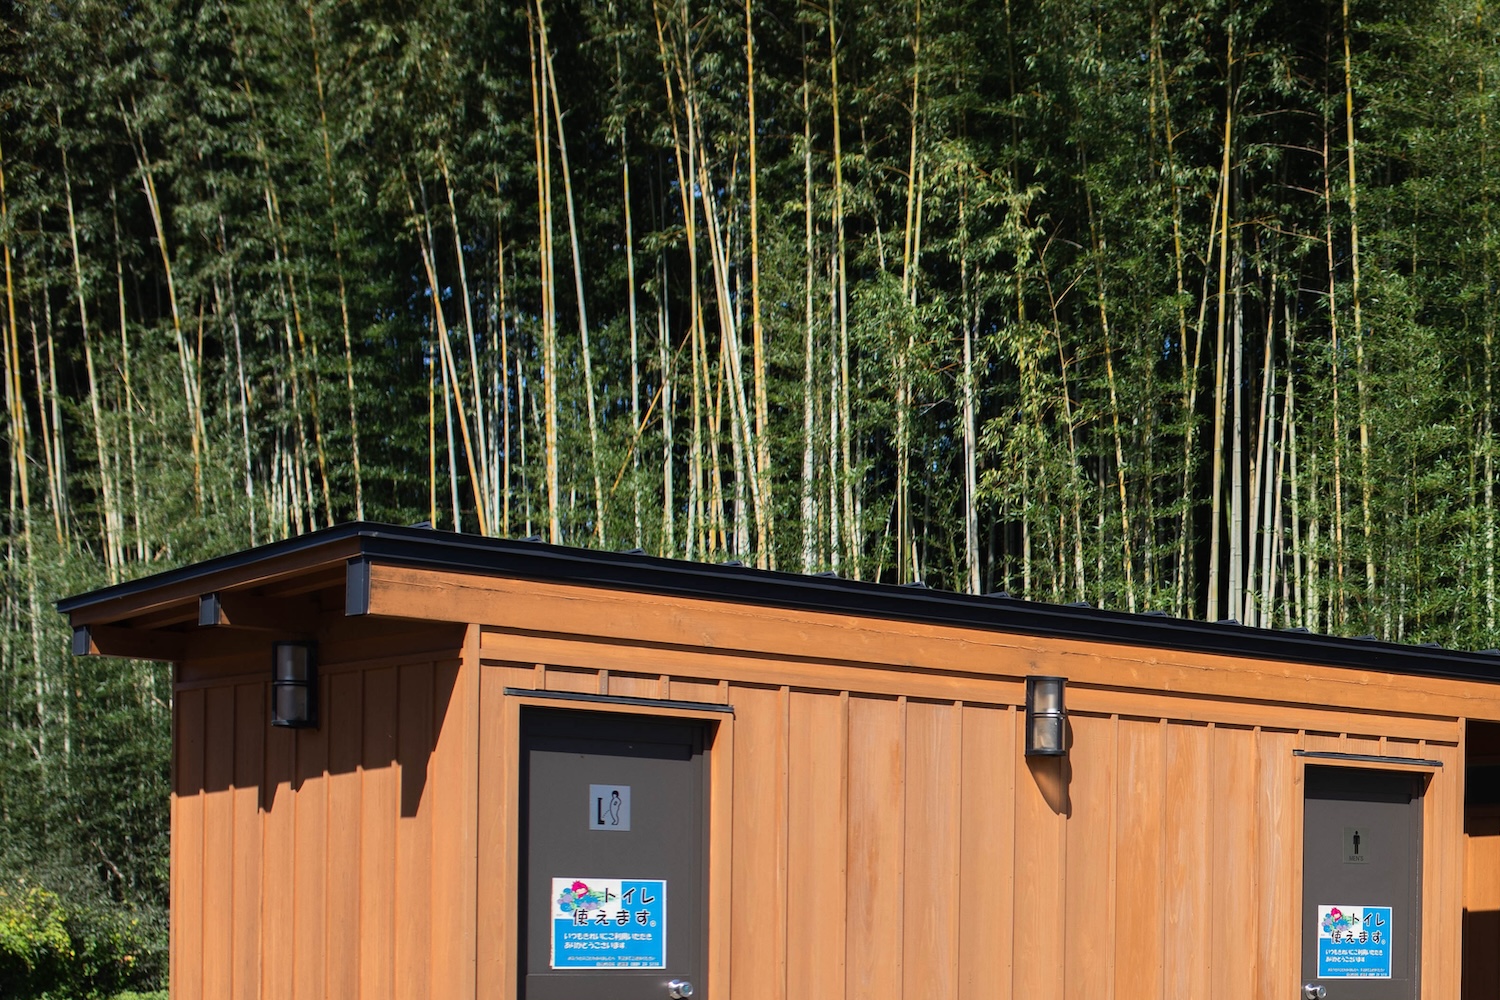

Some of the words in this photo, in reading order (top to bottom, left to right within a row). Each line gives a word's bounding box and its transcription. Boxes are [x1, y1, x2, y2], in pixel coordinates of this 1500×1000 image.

[605, 887, 655, 903] トイレ
[573, 908, 656, 926] 使えます。
[1352, 912, 1385, 926] トイレ
[1331, 930, 1386, 945] 使えます。
